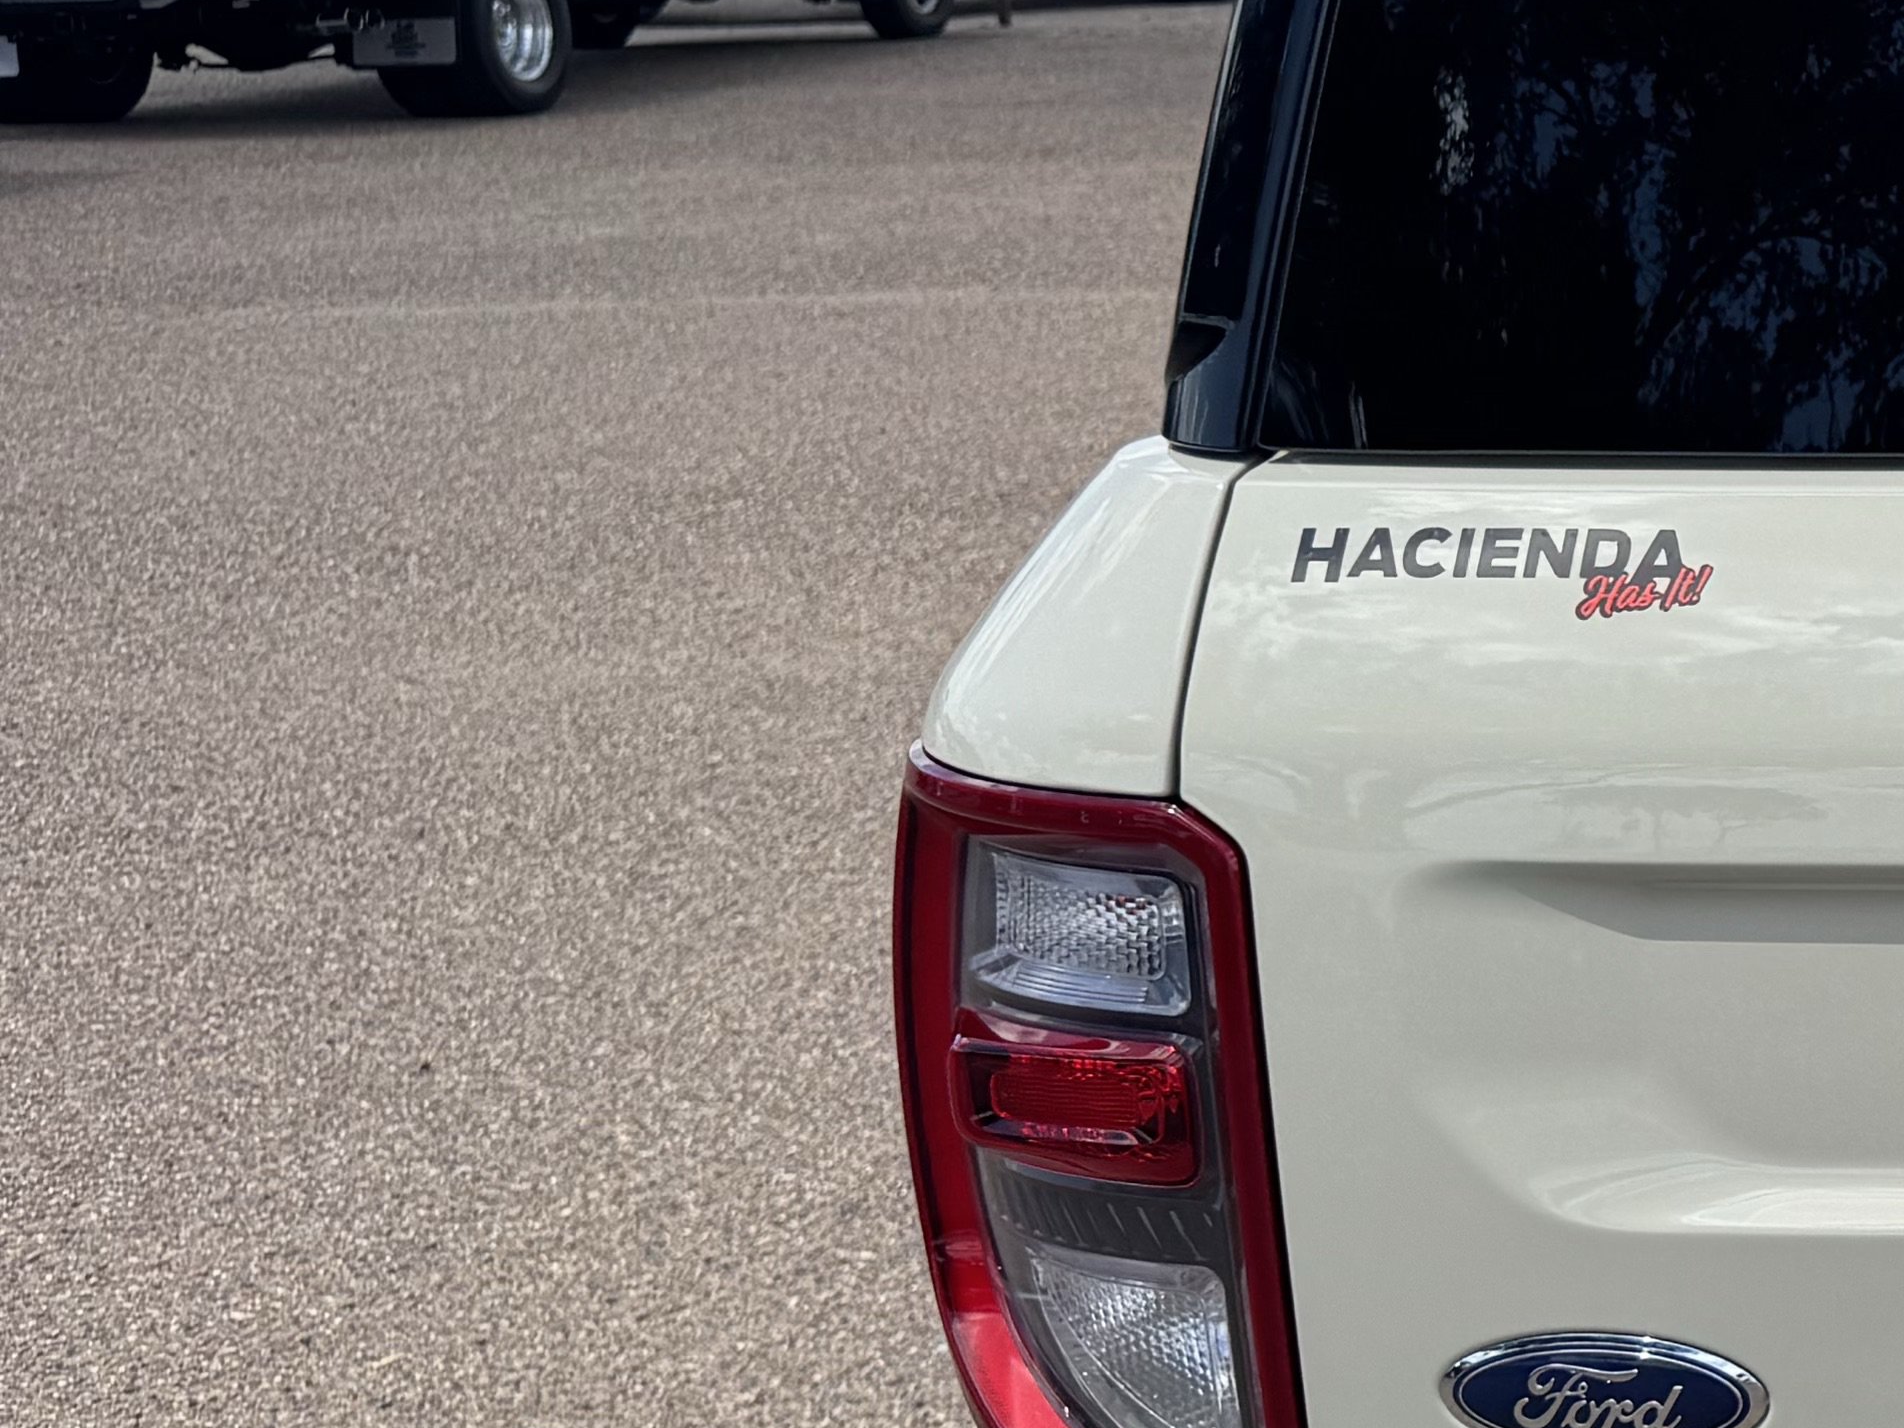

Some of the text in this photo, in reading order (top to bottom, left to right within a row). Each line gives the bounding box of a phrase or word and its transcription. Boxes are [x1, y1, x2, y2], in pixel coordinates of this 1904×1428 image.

[1290, 527, 1686, 584] HACIENDA
[1575, 563, 1714, 621] Has It!
